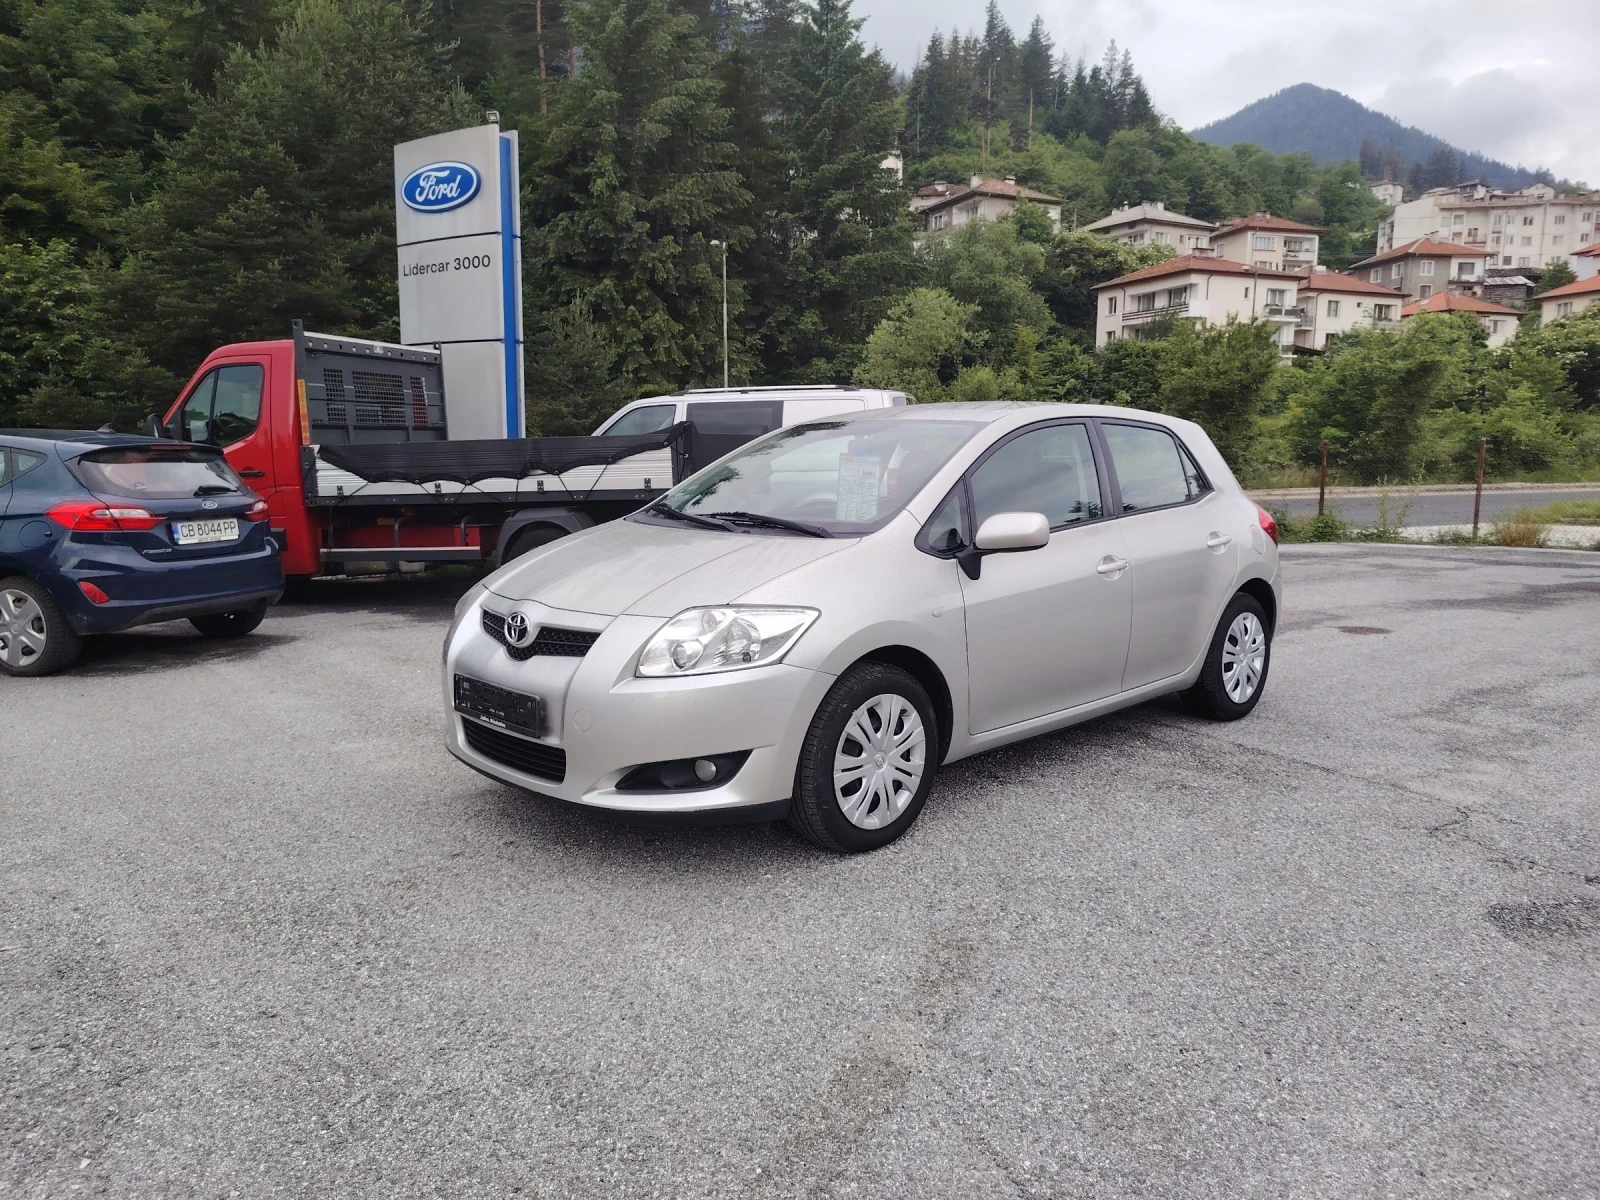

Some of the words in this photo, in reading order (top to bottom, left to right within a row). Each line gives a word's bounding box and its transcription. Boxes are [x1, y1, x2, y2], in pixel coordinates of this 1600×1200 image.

[415, 169, 462, 203] Ford
[402, 261, 450, 277] Lidercar
[453, 254, 491, 271] 3000
[180, 523, 196, 538] CB
[197, 521, 222, 537] 8044
[222, 520, 237, 535] PP
